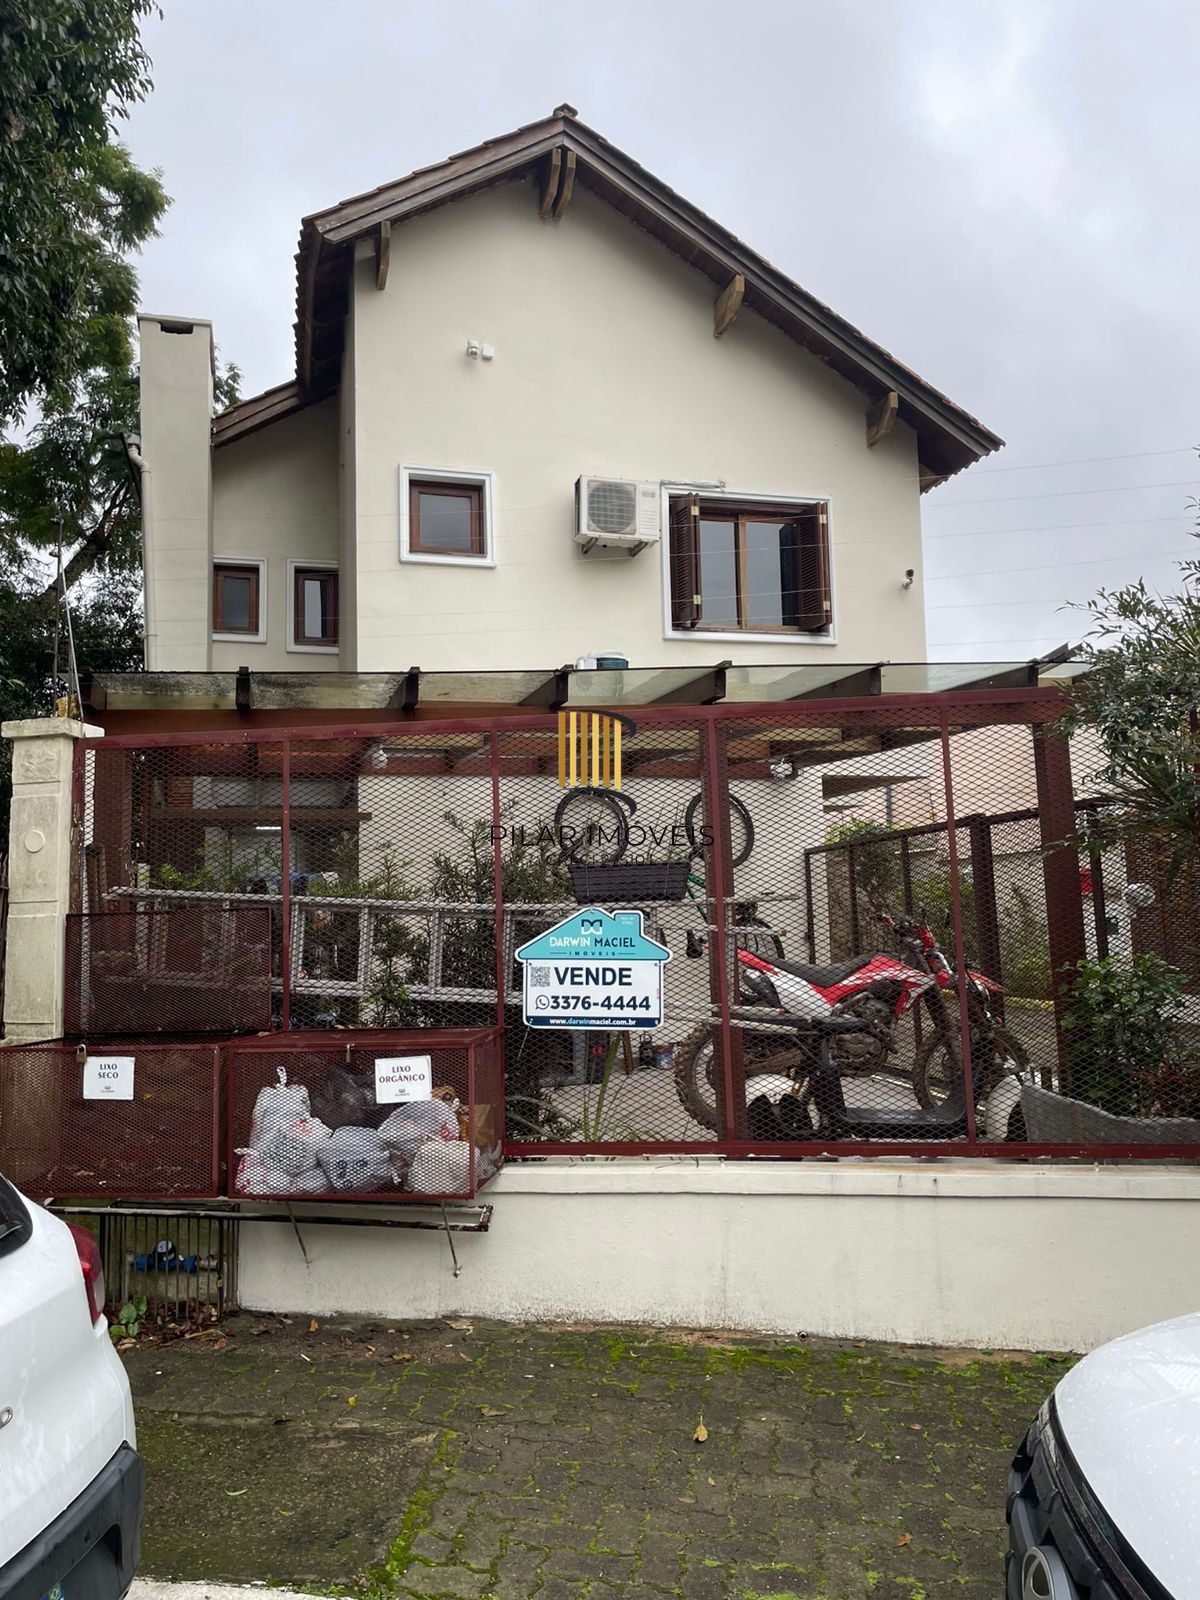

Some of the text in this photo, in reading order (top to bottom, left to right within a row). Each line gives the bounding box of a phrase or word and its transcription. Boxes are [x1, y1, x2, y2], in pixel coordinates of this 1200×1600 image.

[549, 936, 636, 948] DARWIN MACIEL
[553, 967, 633, 986] VENDE
[550, 995, 651, 1011] 3376-4444
[549, 1018, 637, 1026] www.darwinmaciel.com.br
[392, 1065, 411, 1073] LIXO
